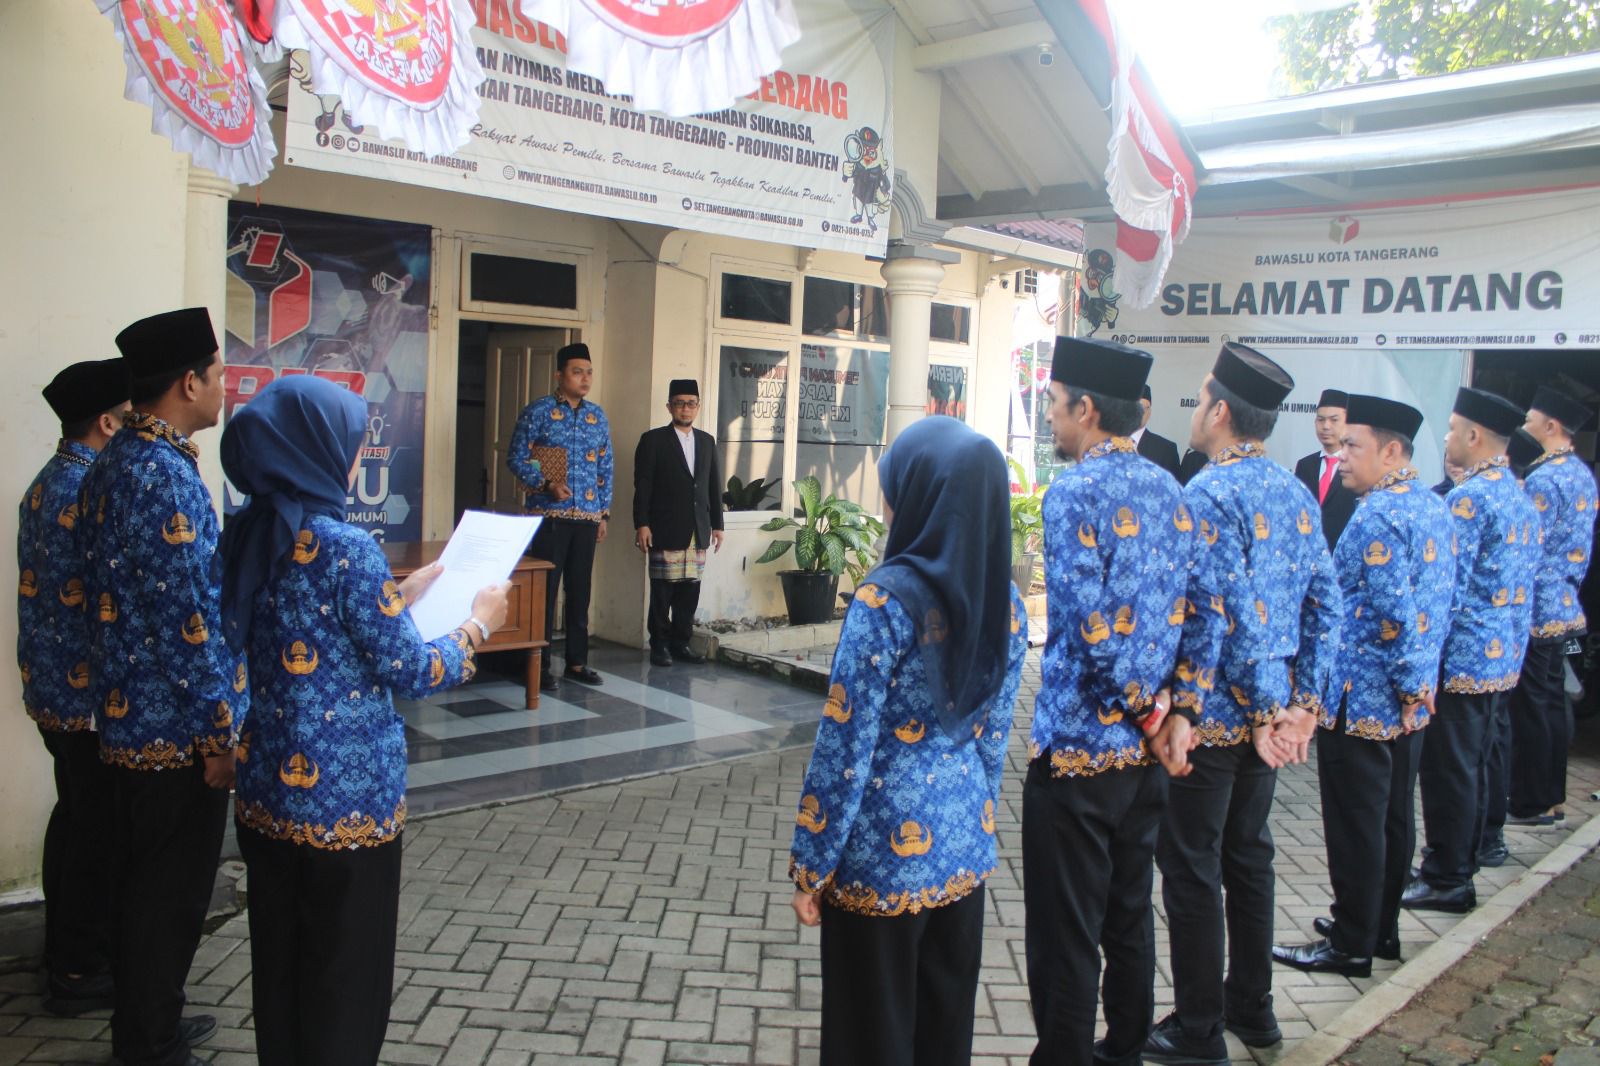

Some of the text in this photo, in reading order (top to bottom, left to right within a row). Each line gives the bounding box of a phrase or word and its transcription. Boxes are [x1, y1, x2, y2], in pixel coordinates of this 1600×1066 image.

[502, 53, 562, 86] NYIMAS
[743, 70, 848, 120] ERANG
[513, 84, 606, 126] TANGERANG,
[609, 106, 646, 133] KOTA
[649, 116, 727, 150] TANGERANG
[736, 135, 794, 163] PROVINSI
[797, 148, 839, 172] BANTEN
[750, 113, 815, 145] SUKARASA,
[362, 141, 405, 160] BAWASLU
[469, 123, 517, 144] Rakyat
[520, 134, 559, 152] Awasi
[612, 152, 657, 172] Bersama
[662, 162, 705, 182] Bawaslu
[710, 171, 755, 190] Tegakkan
[759, 181, 799, 198] Keadilan
[517, 170, 658, 204] WWW.TANGERANGKOTA.BAWASLU.GO.ID
[1255, 246, 1439, 266] BAWASLU KOTA TANGERANG
[1160, 270, 1563, 317] SELAMAT DATANG
[1137, 335, 1210, 344] BAWASLU KOTA TANGERANG
[1291, 402, 1317, 414] UMUM
[361, 447, 390, 460] TASI)
